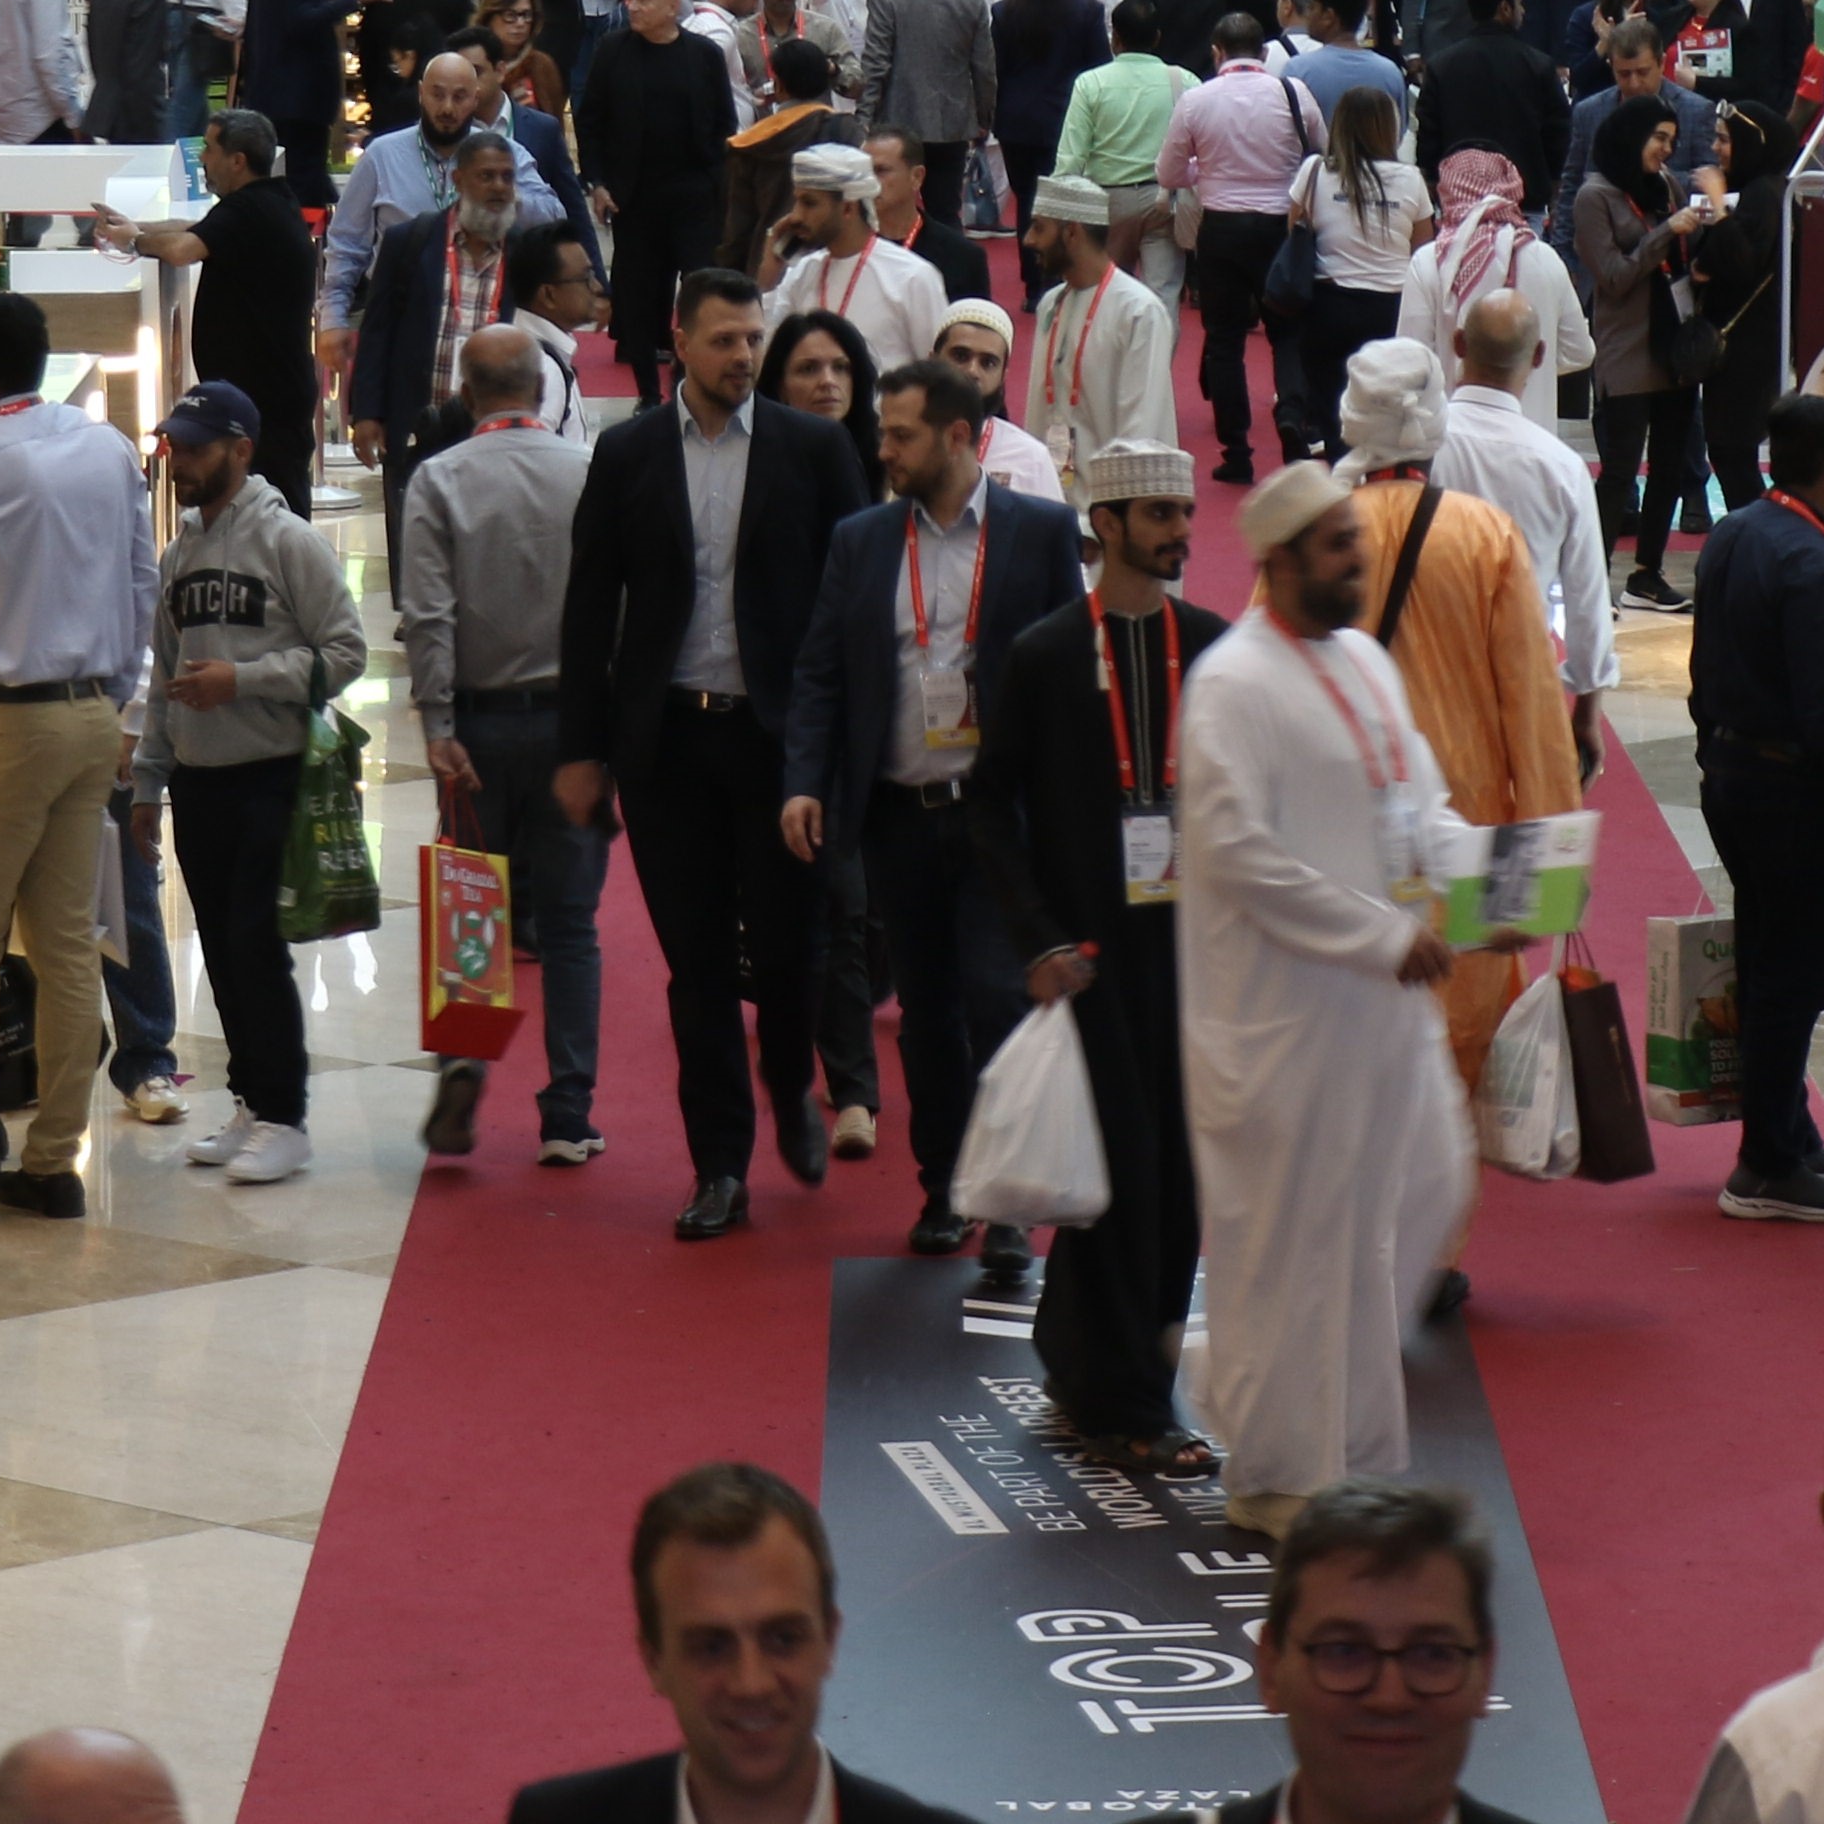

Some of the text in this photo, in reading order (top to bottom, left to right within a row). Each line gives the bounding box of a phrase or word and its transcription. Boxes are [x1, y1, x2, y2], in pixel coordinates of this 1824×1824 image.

[938, 1413, 1088, 1531] BE PART OF THE
[1017, 1608, 1288, 1735] TOP
